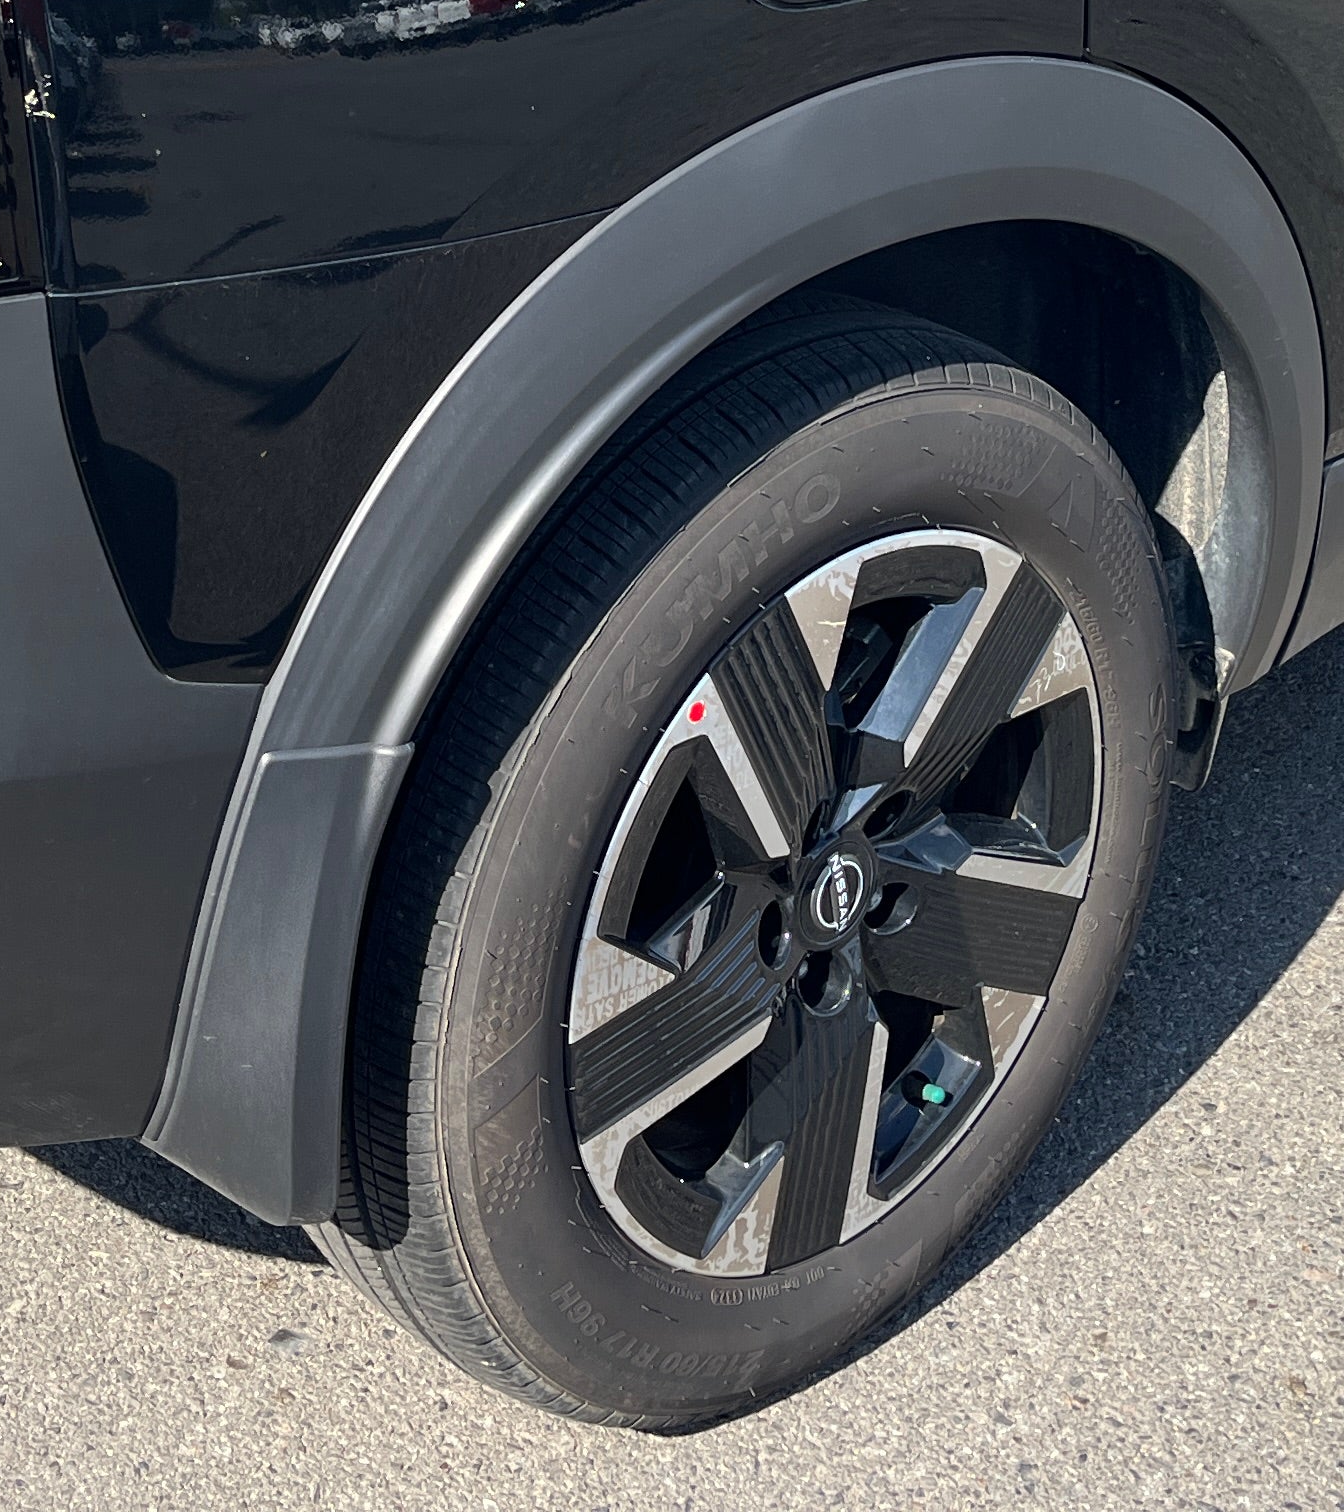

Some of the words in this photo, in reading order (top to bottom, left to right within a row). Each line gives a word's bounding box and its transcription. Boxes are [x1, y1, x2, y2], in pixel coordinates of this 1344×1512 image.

[601, 472, 841, 729] KUMHO
[828, 853, 849, 932] NISSAN
[548, 1281, 607, 1337] 96H
[599, 1330, 660, 1368] R17
[659, 1348, 765, 1378] 215/60
